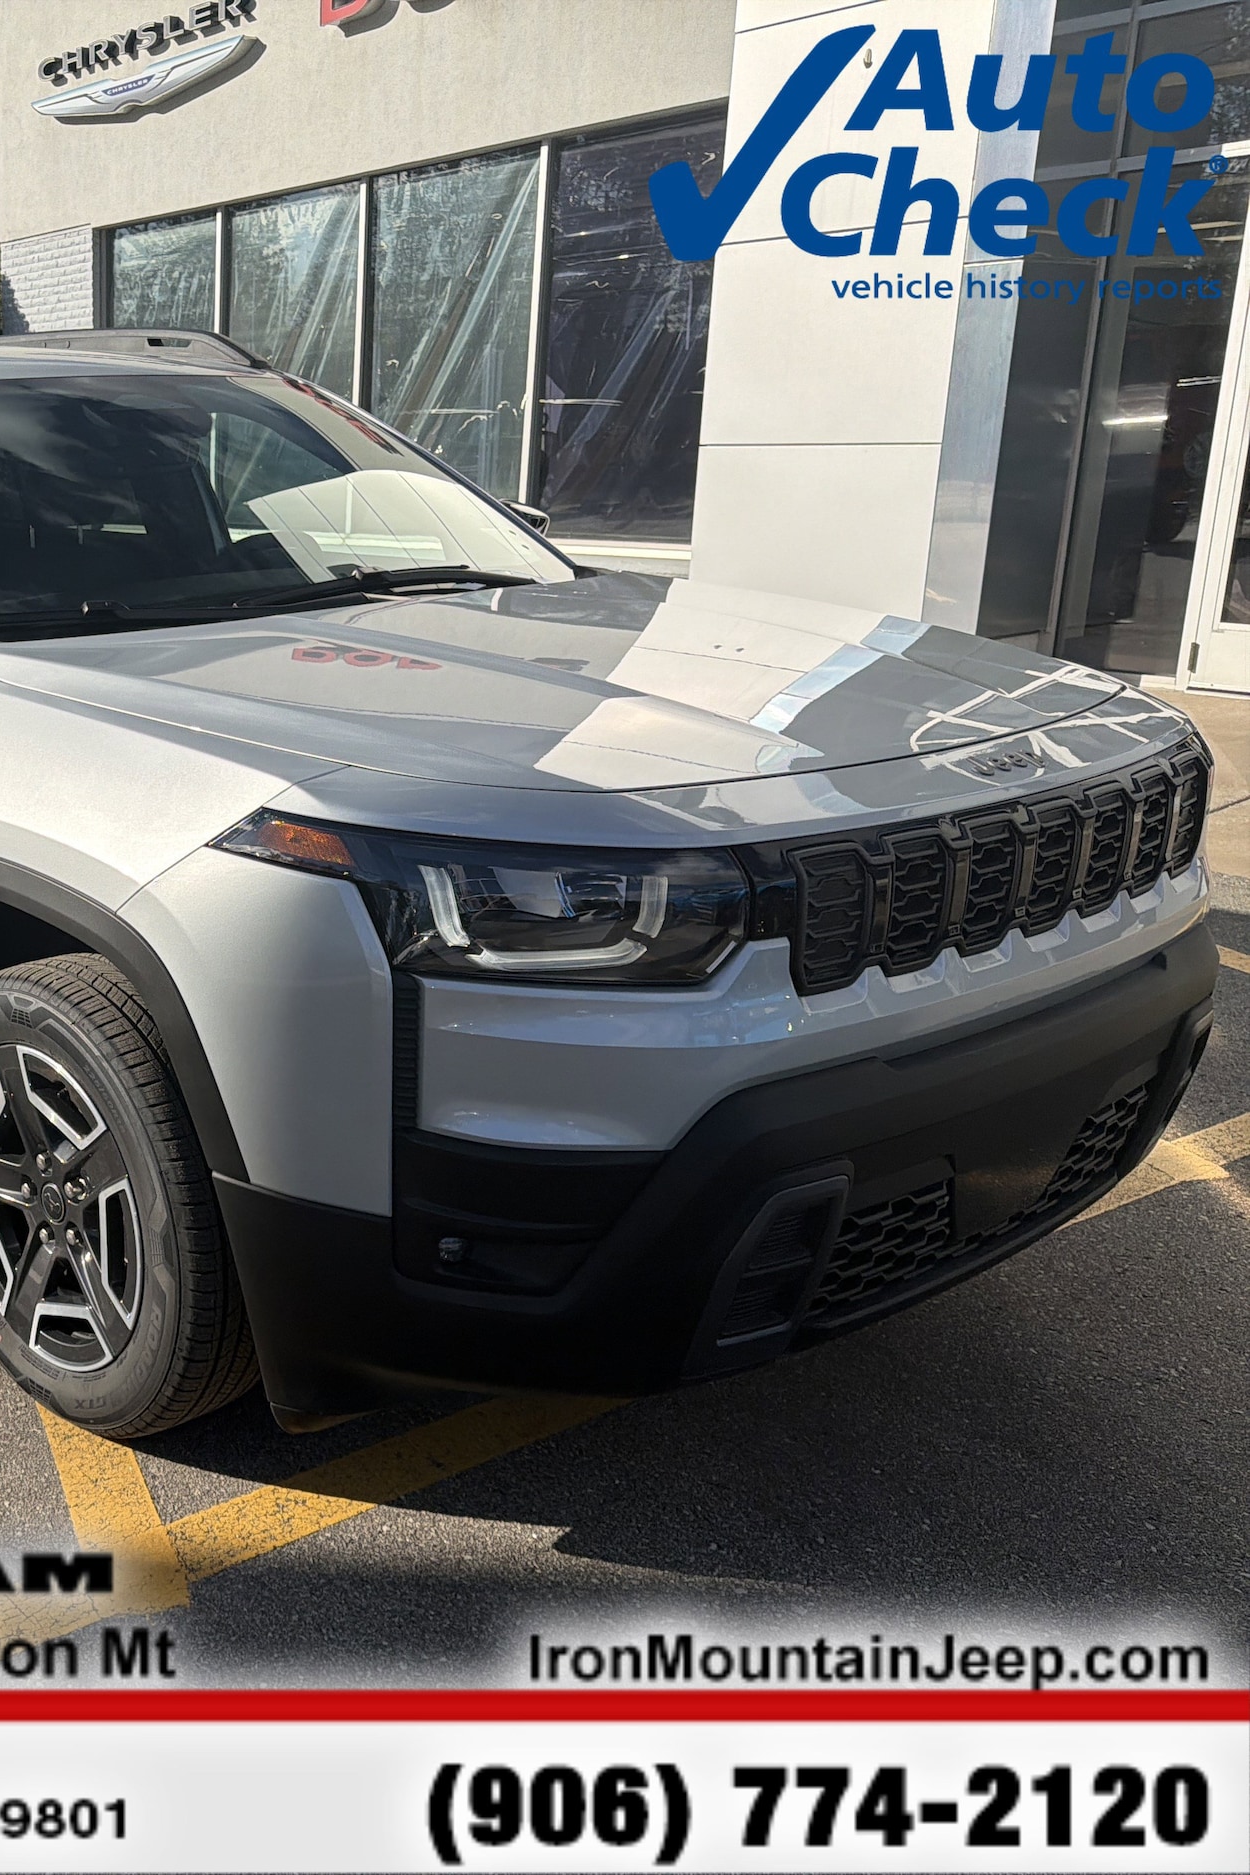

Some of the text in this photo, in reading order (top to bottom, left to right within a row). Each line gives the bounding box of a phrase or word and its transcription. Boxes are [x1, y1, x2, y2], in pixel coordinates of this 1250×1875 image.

[38, 0, 250, 81] CHRYSLER
[106, 78, 150, 95] CHRYSLER
[966, 749, 1046, 777] Jeep
